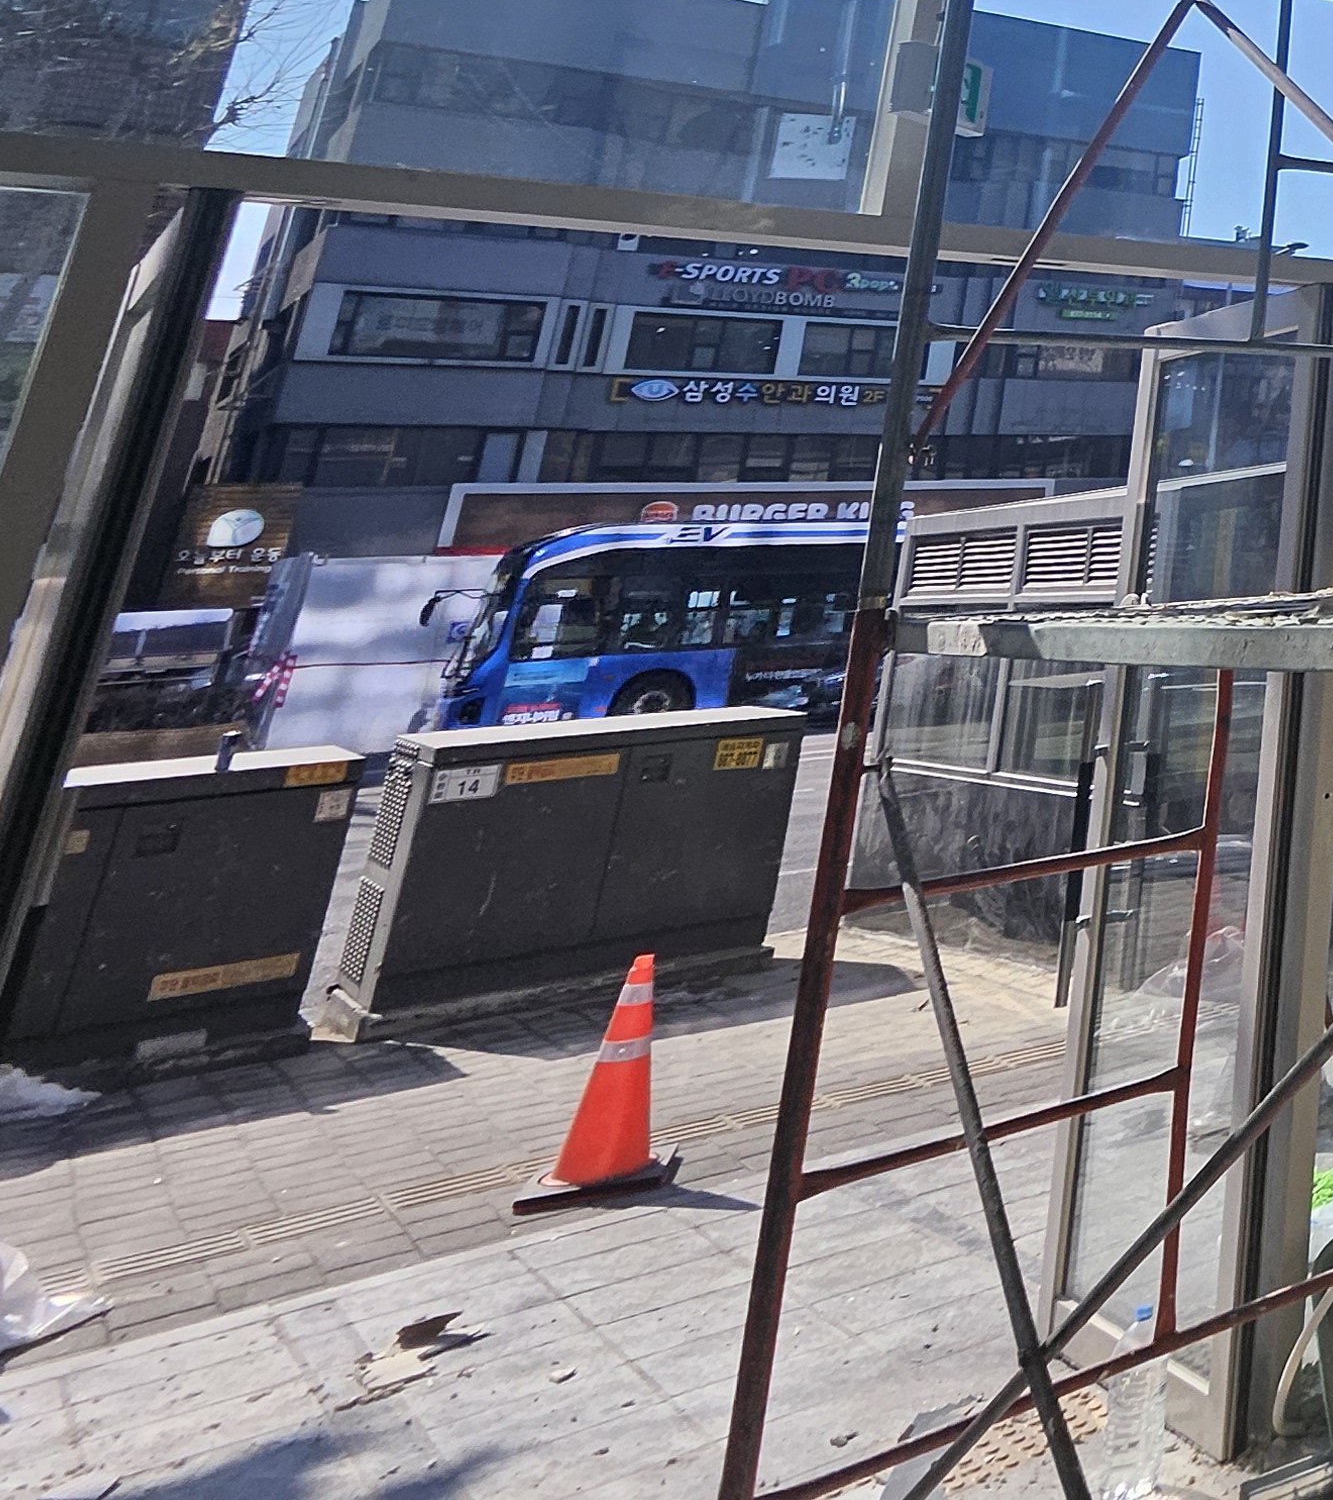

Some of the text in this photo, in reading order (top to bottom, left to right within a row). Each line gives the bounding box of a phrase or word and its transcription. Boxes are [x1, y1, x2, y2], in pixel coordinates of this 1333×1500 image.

[786, 266, 839, 293] PC
[682, 380, 860, 406] 삼성수안과의원
[692, 502, 829, 521] BURGER
[836, 501, 915, 520] KIG
[250, 547, 282, 563] 운동
[457, 779, 480, 797] 14
